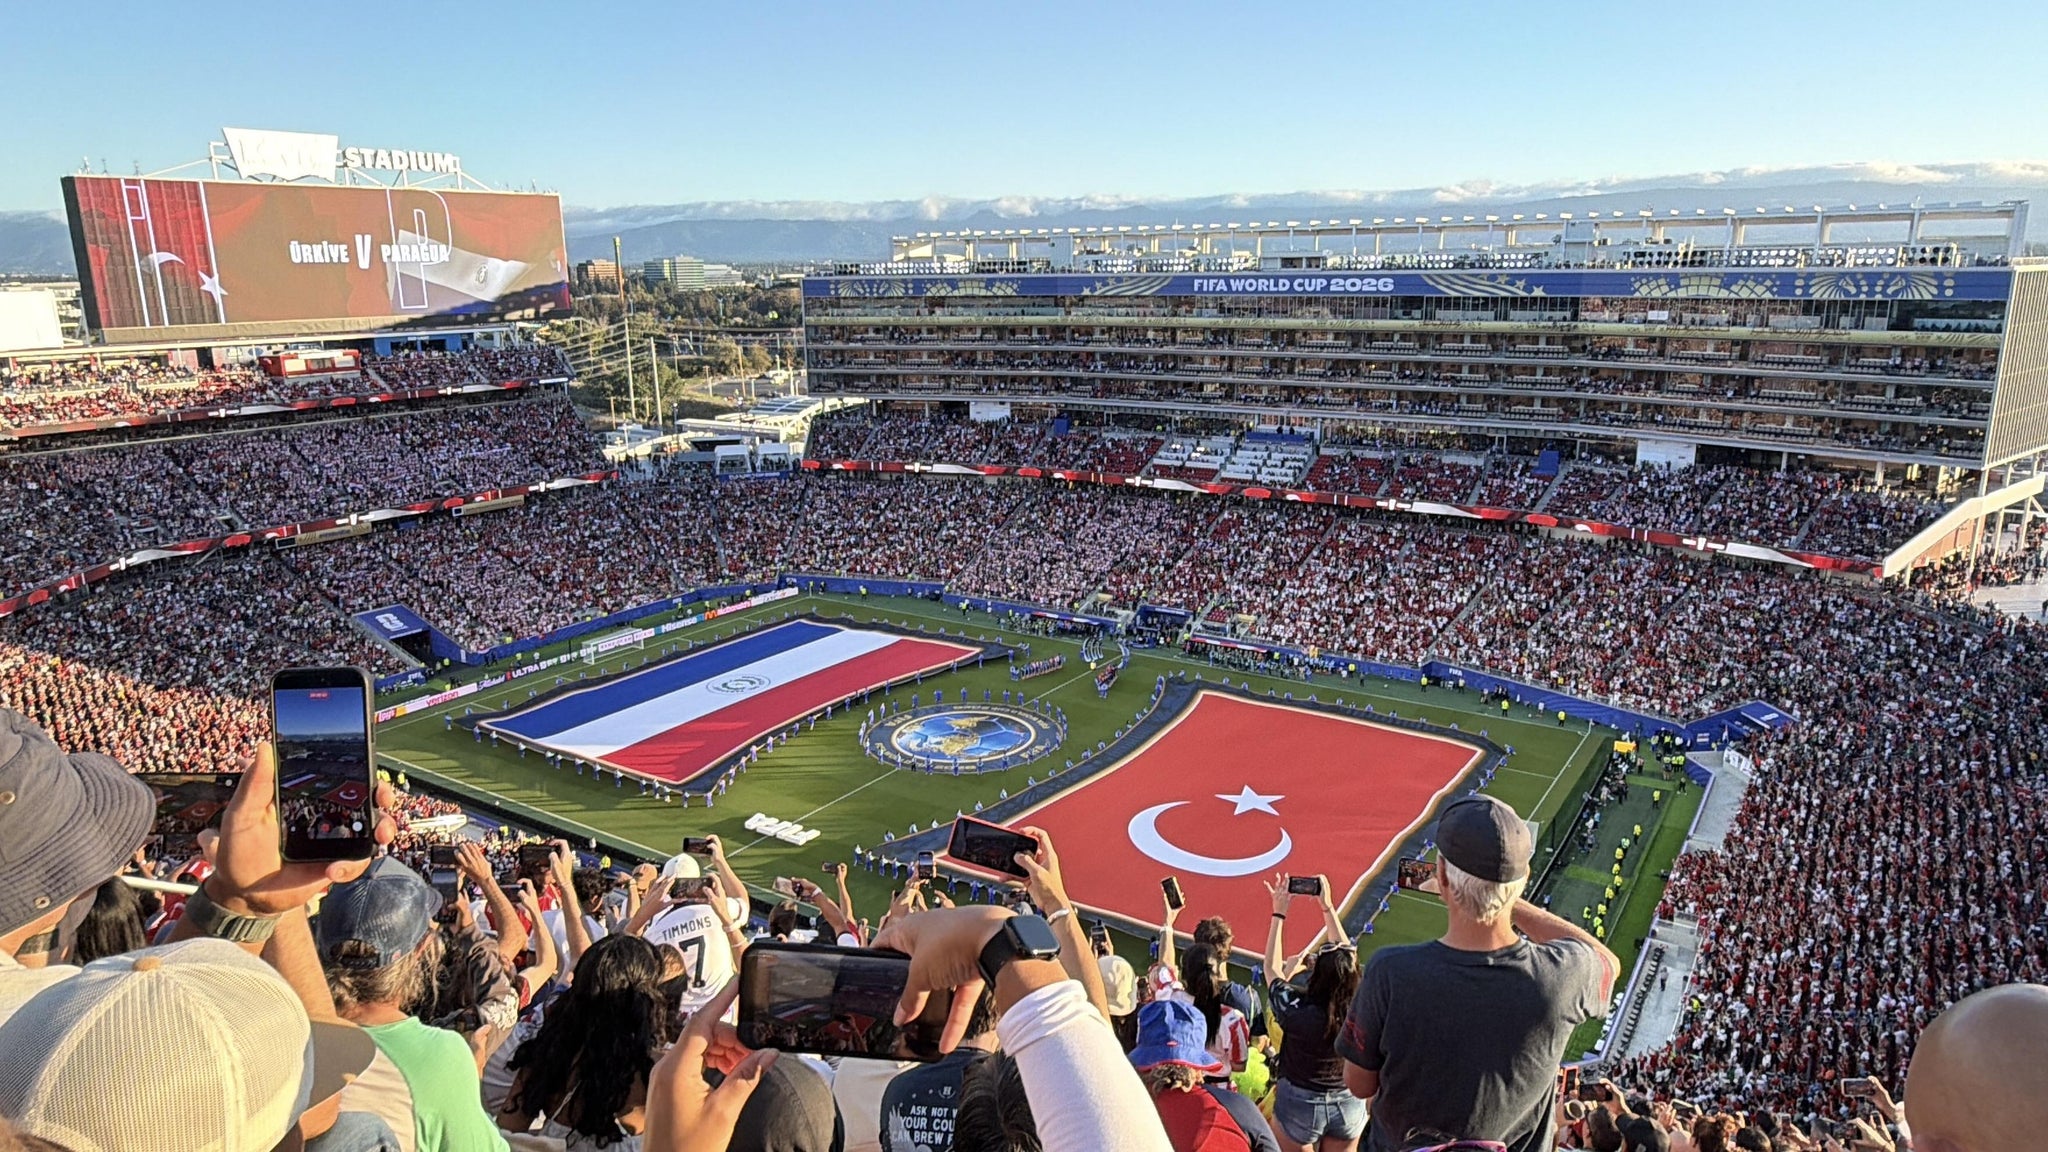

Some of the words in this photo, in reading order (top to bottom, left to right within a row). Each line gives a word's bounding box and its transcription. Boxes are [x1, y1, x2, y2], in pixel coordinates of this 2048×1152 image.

[344, 147, 457, 173] STADIUM
[355, 234, 372, 270] V
[1193, 278, 1228, 292] FIFA
[1230, 278, 1291, 292] WORLD
[1292, 278, 1328, 292] CUP
[1329, 277, 1394, 292] 2026
[661, 616, 698, 633] Hisense
[512, 662, 540, 679] ULTRA
[662, 916, 712, 941] TIMMONS
[678, 935, 706, 988] 7
[910, 1105, 928, 1116] ASK
[931, 1107, 949, 1118] NOT
[900, 1116, 928, 1130] YOUR
[914, 1130, 944, 1145] BREW
